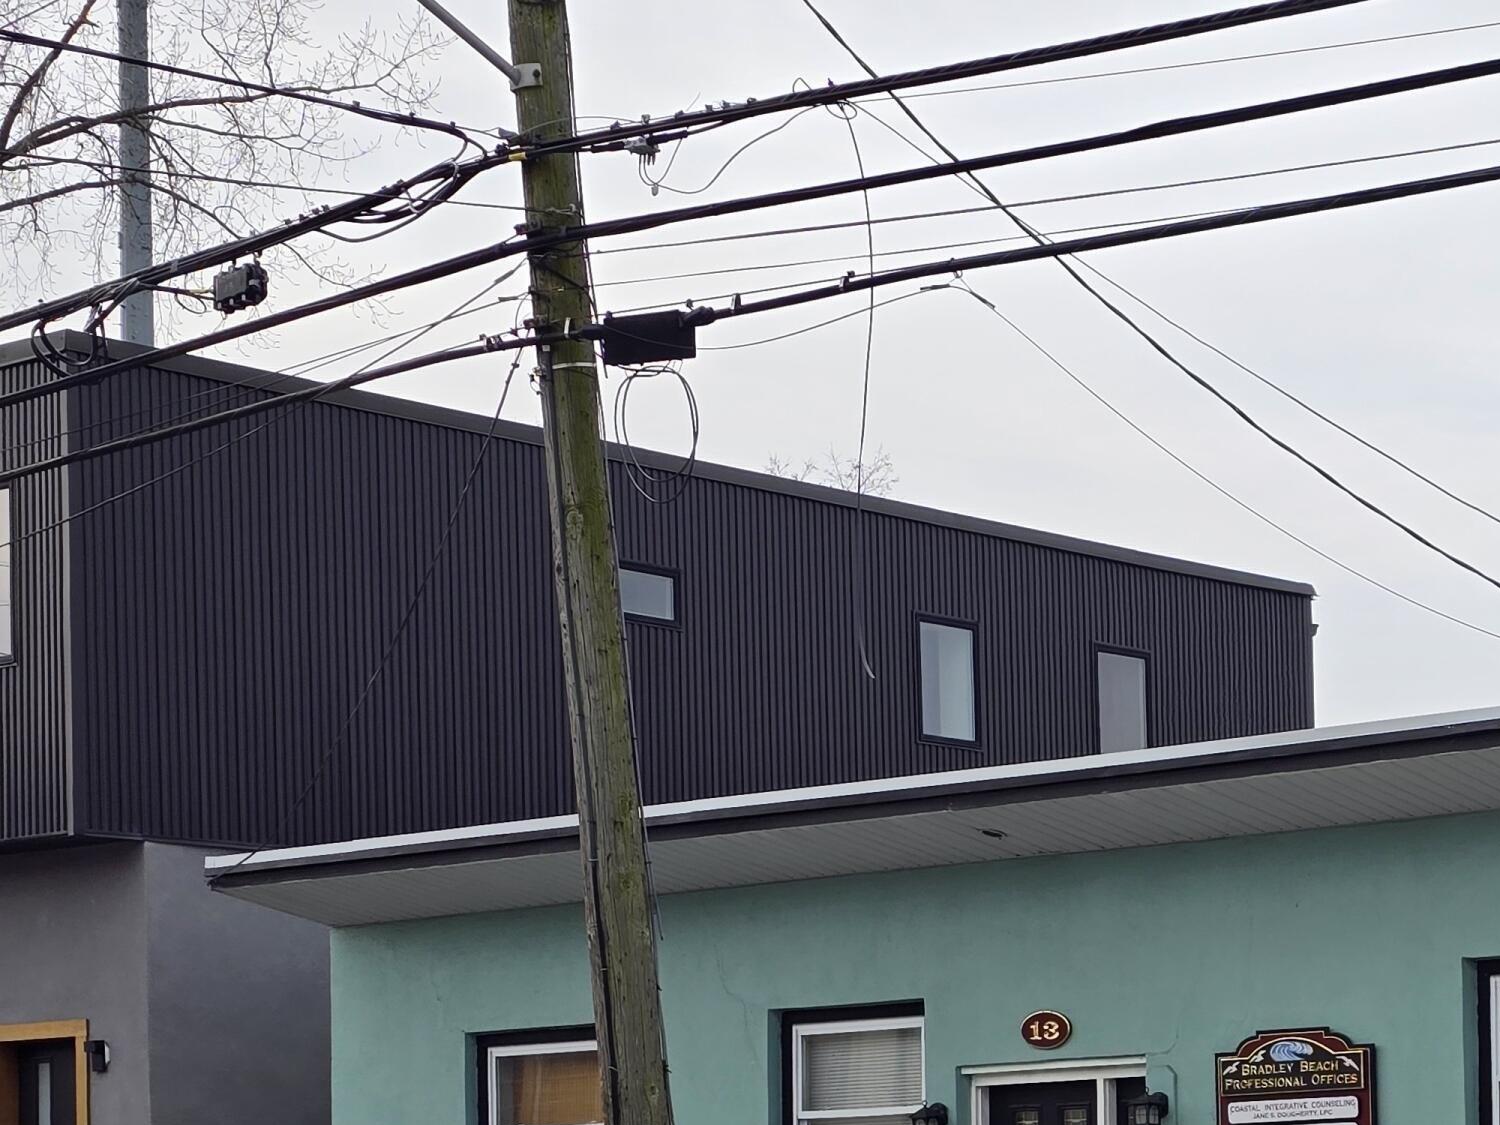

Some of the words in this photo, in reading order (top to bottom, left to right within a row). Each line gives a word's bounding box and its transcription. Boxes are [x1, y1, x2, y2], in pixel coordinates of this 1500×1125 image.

[1029, 1020, 1060, 1040] 13
[1241, 1063, 1294, 1076] BRADLEY
[1300, 1060, 1339, 1073] BEACH
[1224, 1076, 1308, 1090] PROFESSIONAL
[1311, 1073, 1358, 1085] OFFICES
[1229, 1105, 1261, 1113] COASTAL
[1264, 1101, 1308, 1111] INTEGRATIVE
[1311, 1099, 1356, 1109] COUNSELING
